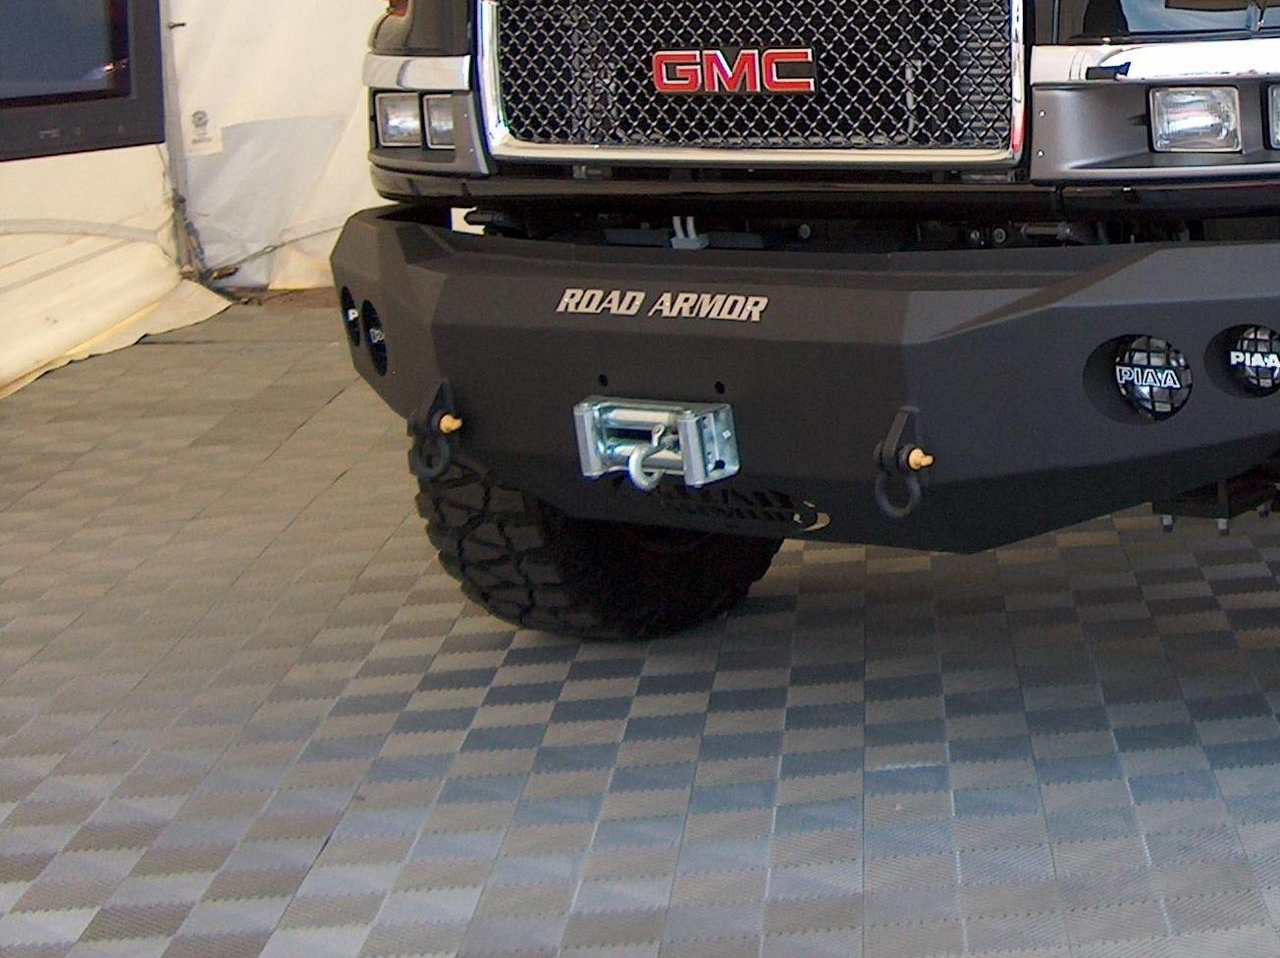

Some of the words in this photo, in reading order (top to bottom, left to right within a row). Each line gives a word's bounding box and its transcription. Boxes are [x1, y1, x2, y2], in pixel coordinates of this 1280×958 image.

[652, 48, 815, 93] GMC
[556, 288, 647, 316] ROAD
[648, 292, 769, 322] ARMOR
[1116, 365, 1181, 389] PIAA
